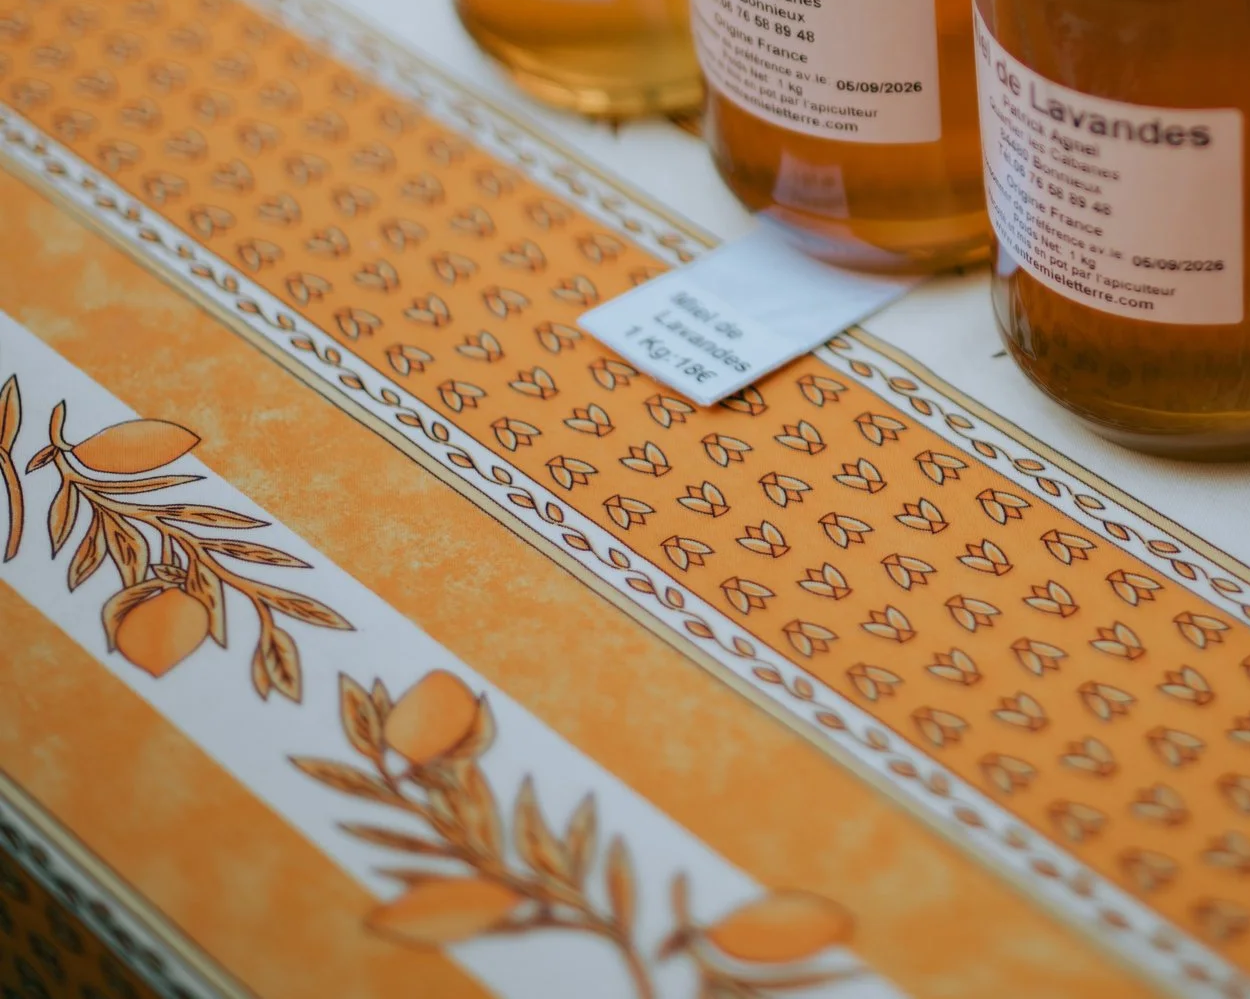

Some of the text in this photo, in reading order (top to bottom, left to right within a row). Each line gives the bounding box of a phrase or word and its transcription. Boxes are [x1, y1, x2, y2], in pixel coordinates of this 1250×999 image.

[737, 5, 751, 23] 76
[755, 13, 771, 32] 58
[774, 22, 792, 38] 89
[797, 28, 816, 45] 48
[758, 37, 809, 64] France
[780, 92, 800, 107] par
[788, 80, 804, 97] kg
[836, 79, 923, 94] 05/09/2026
[996, 61, 1021, 97] de
[1029, 80, 1212, 148] Lavandes
[1006, 173, 1046, 213] Origine
[1050, 205, 1103, 237] France
[1026, 210, 1086, 250] préférence
[1034, 245, 1047, 260] en
[1049, 255, 1068, 272] pot
[1071, 265, 1092, 281] par
[1070, 250, 1076, 261] 1
[1081, 254, 1097, 271] kg
[624, 325, 642, 338] 1
[653, 308, 752, 374] Lavandes
[714, 321, 743, 341] de
